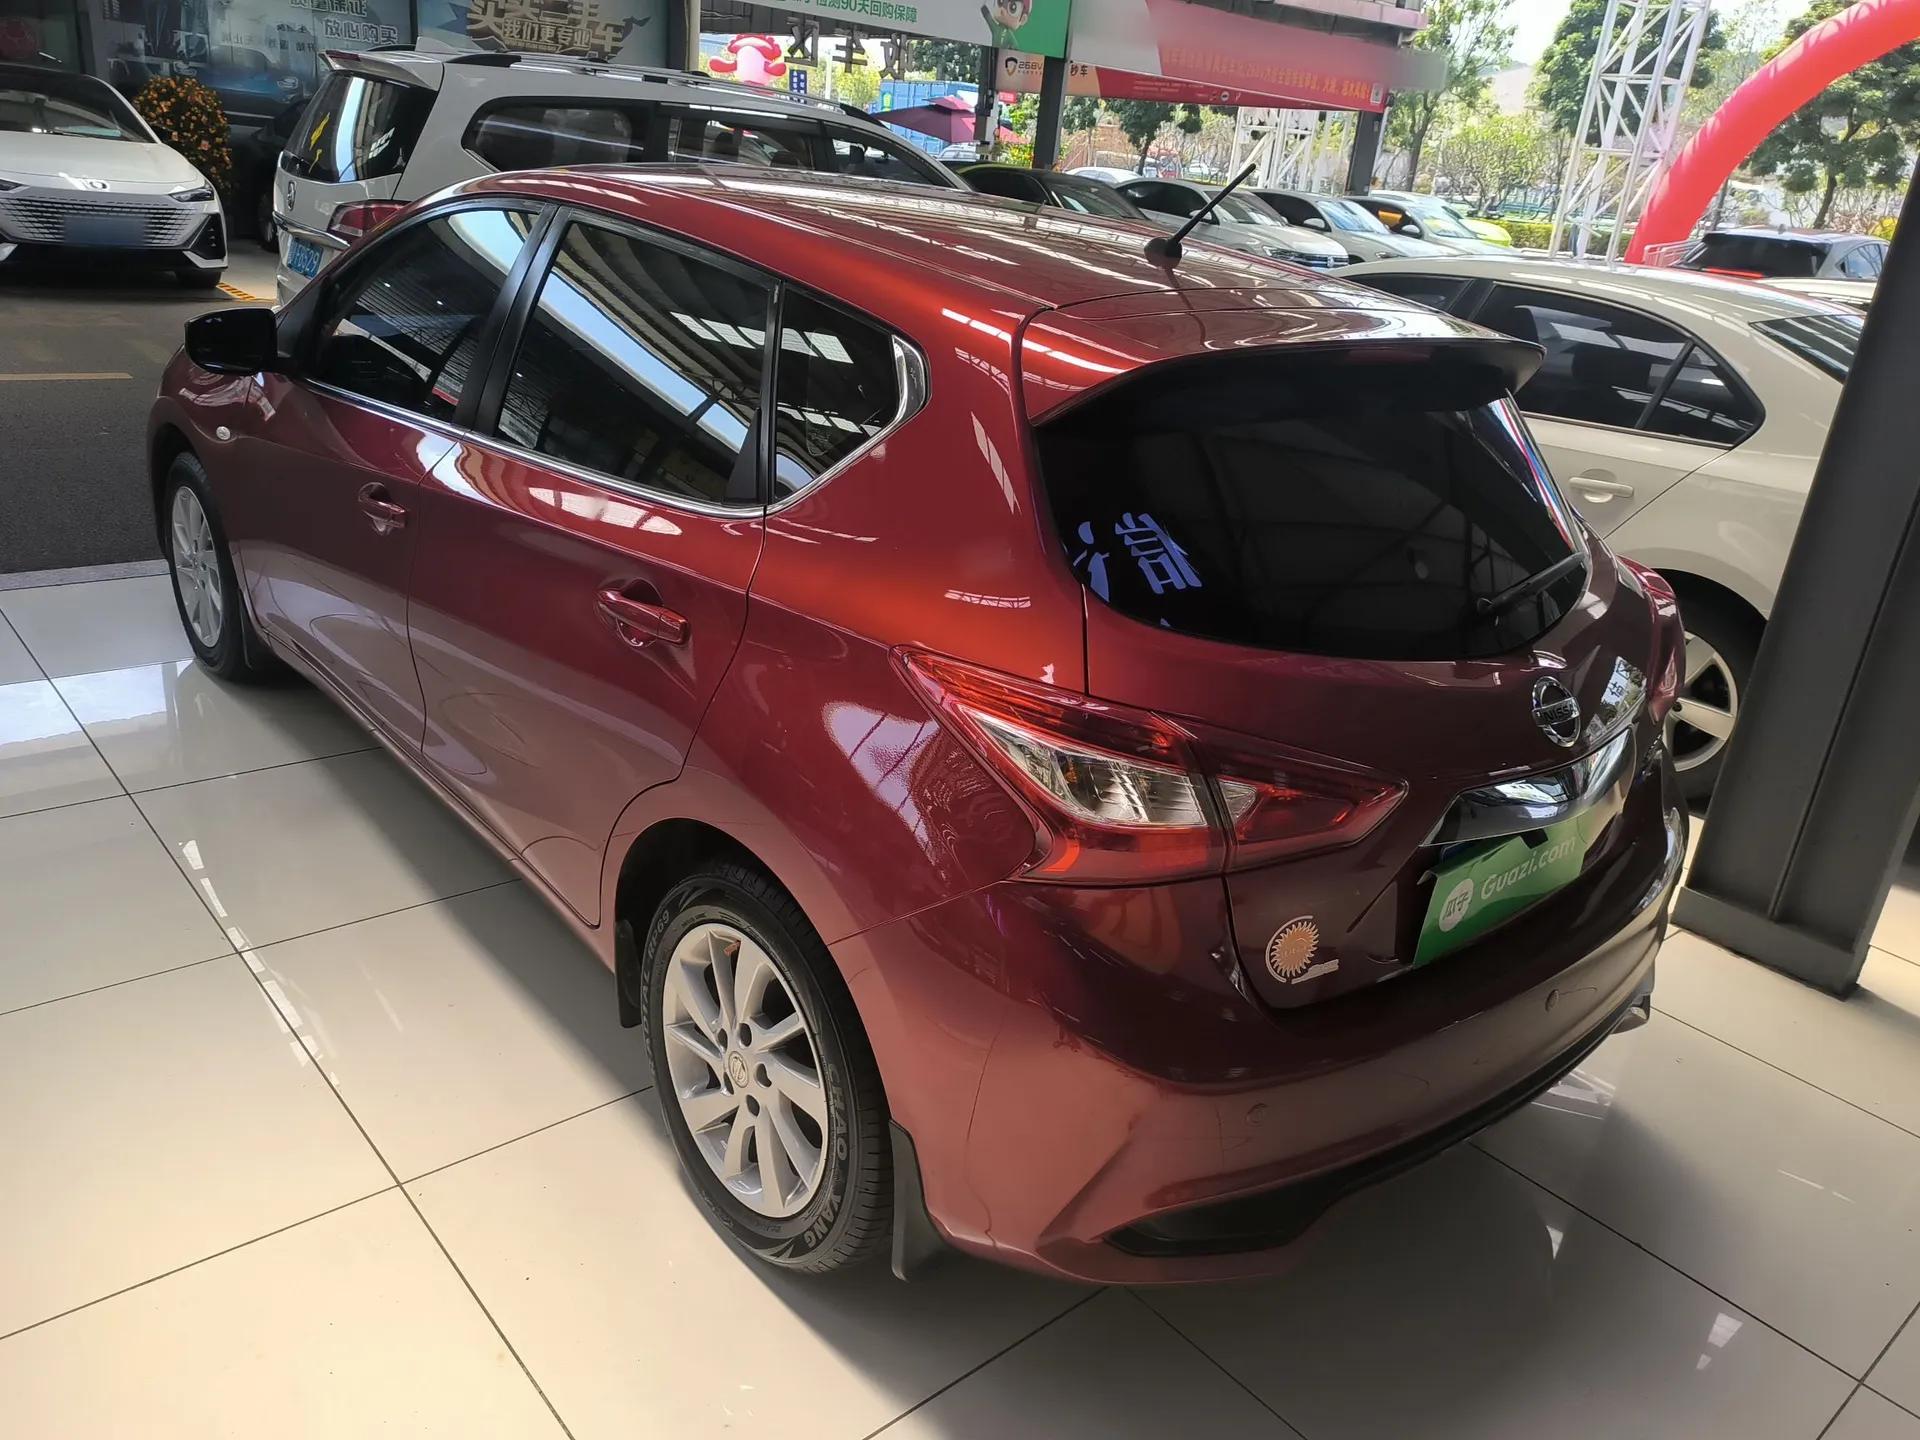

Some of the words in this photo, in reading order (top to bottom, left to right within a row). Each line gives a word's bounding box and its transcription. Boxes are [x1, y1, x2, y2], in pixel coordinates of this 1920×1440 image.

[325, 18, 397, 45] 放心购买
[504, 18, 590, 48] 我们更专业
[1481, 837, 1576, 900] Guazi.com
[828, 1063, 849, 1162] CHAO
[803, 1194, 842, 1249] YANG
